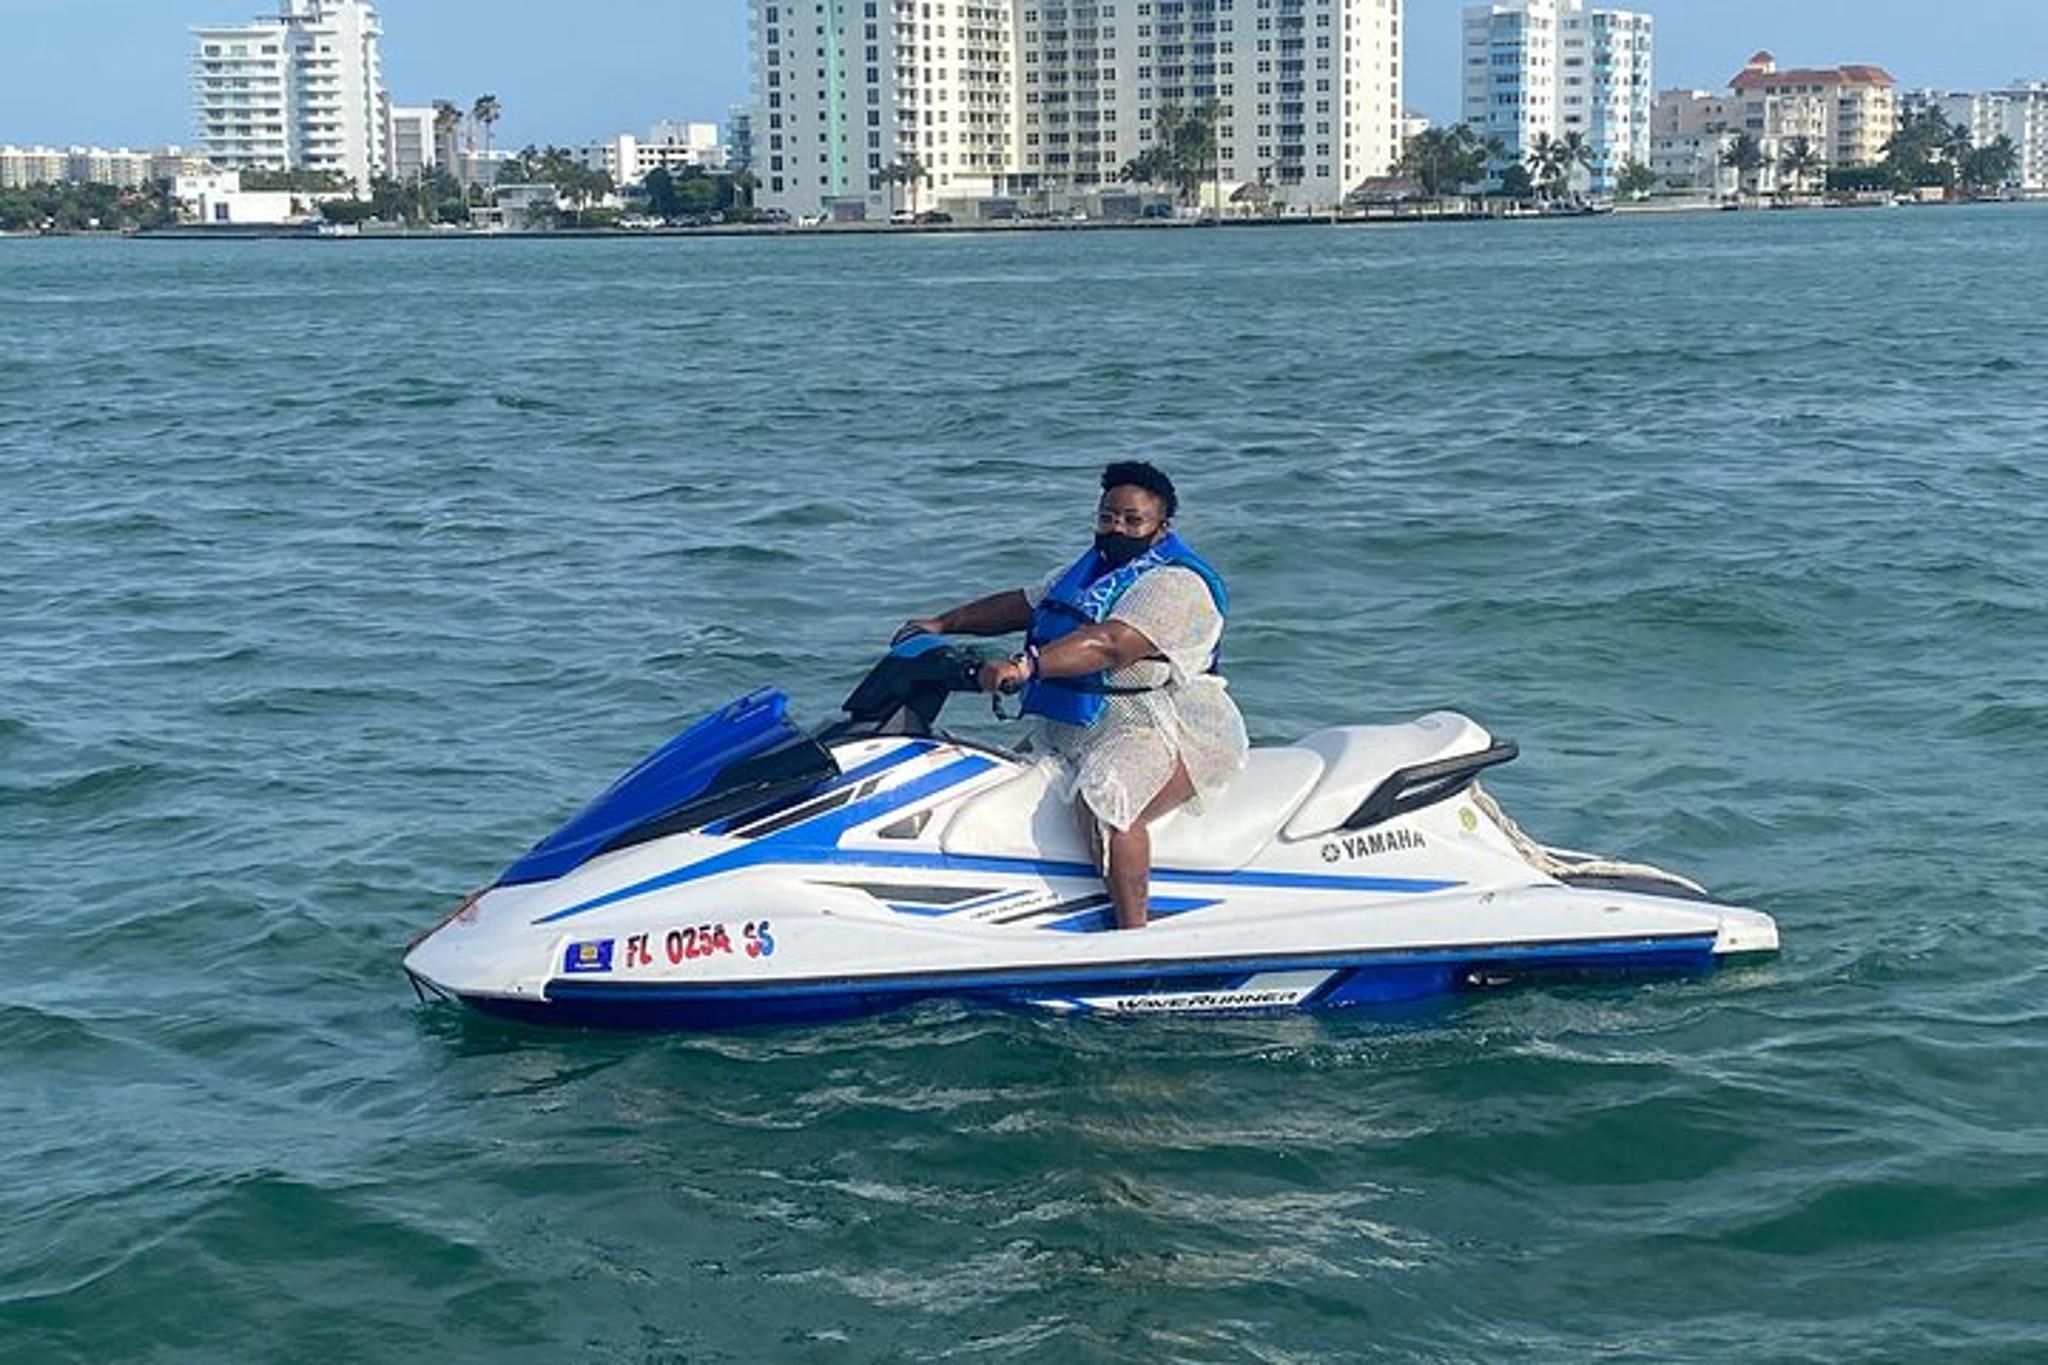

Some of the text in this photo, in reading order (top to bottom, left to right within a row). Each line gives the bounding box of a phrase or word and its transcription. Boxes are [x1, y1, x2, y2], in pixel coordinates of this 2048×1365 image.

[1342, 829, 1426, 859] YAMAHA
[626, 932, 652, 968] FL
[743, 920, 775, 958] SS
